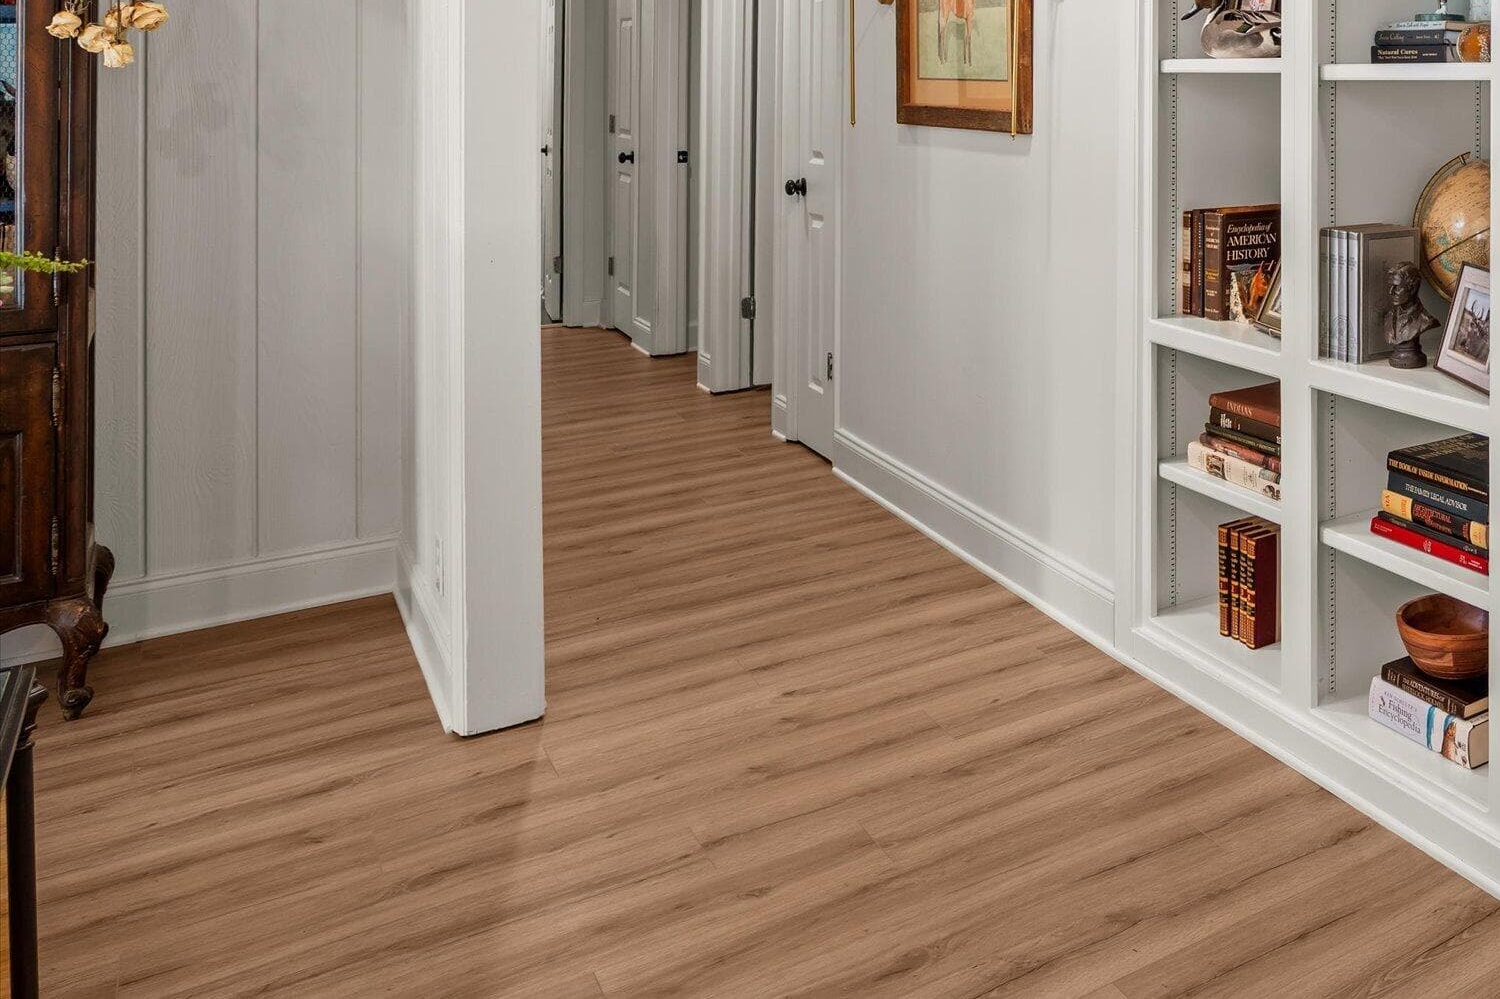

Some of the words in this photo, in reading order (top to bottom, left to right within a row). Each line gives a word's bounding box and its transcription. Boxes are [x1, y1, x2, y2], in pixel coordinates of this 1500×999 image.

[1226, 223, 1265, 235] Encyclopedia
[1226, 233, 1277, 247] AMERICAN
[1226, 247, 1270, 261] HISTORY
[1388, 458, 1399, 468] THE
[1398, 461, 1412, 473] BOOK
[1411, 465, 1418, 474] OF
[1418, 468, 1434, 480] INSIDE
[1434, 473, 1469, 491] INFORMATION
[1405, 483, 1415, 492] THE
[1414, 486, 1430, 498] FAMILY
[1430, 492, 1446, 503] LEGAL
[1445, 497, 1468, 511] ADVISOR
[1409, 679, 1440, 698] ADVENTURES
[1378, 704, 1421, 734] Encyclopedia
[1388, 699, 1412, 722] Fishing
